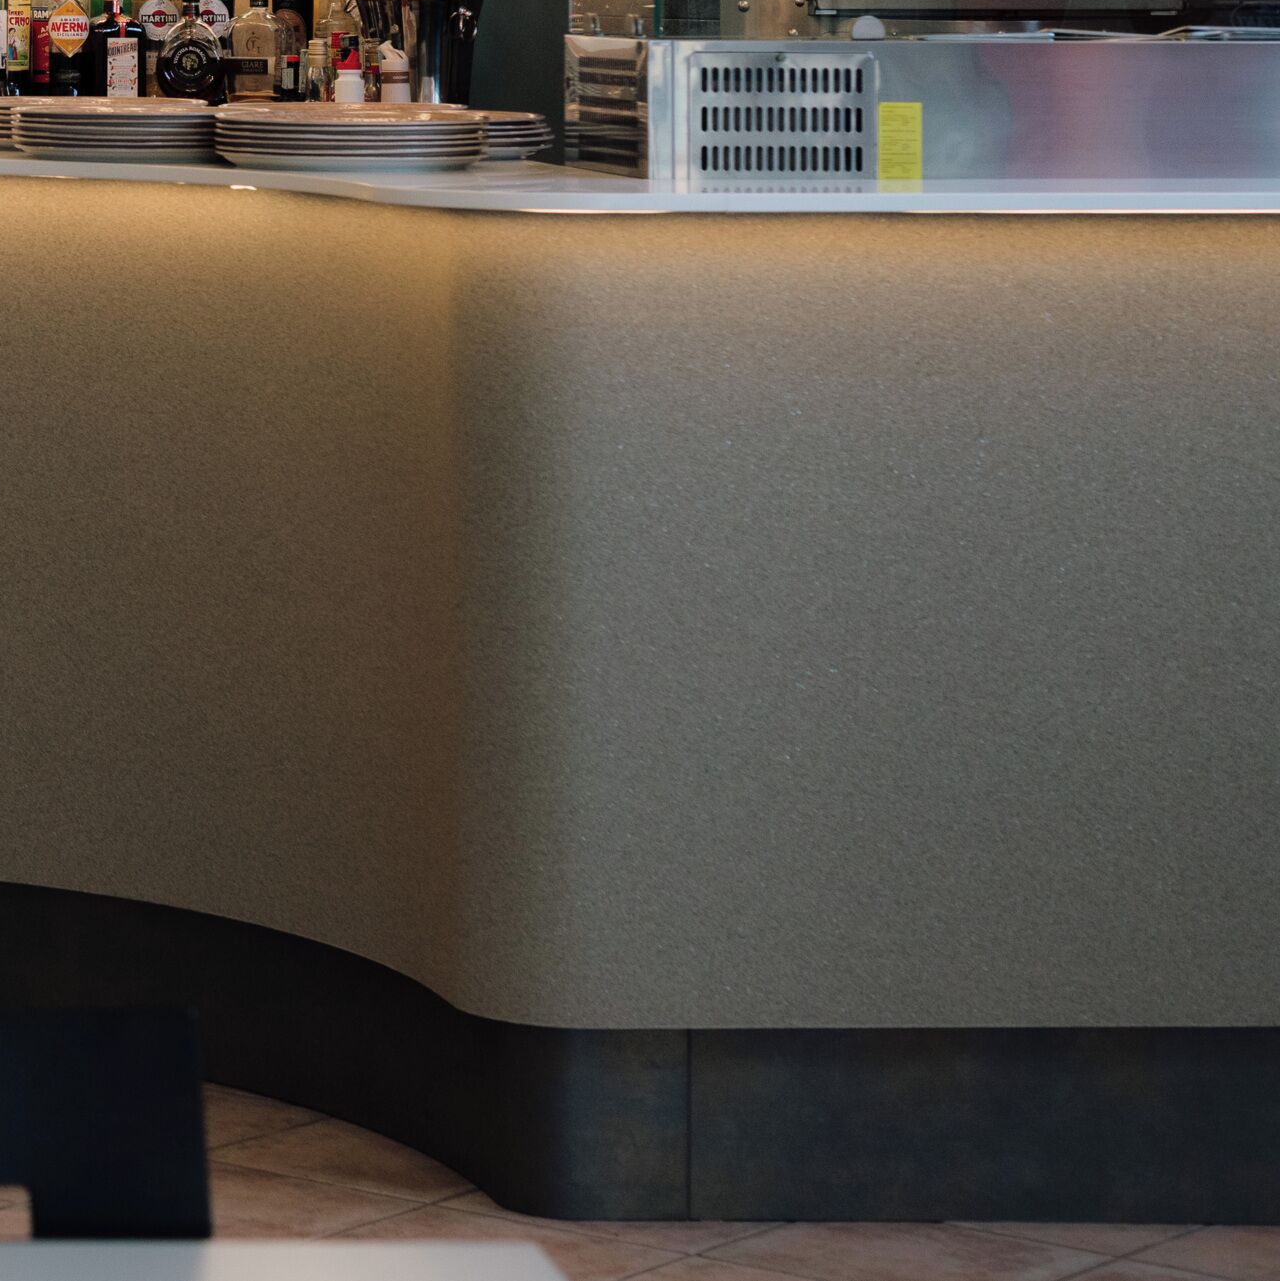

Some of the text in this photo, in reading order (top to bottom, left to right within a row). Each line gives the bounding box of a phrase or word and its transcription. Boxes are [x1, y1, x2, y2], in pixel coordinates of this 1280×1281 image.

[33, 10, 49, 19] RAM
[142, 14, 177, 23] MARTINI
[51, 22, 88, 32] AVERNA
